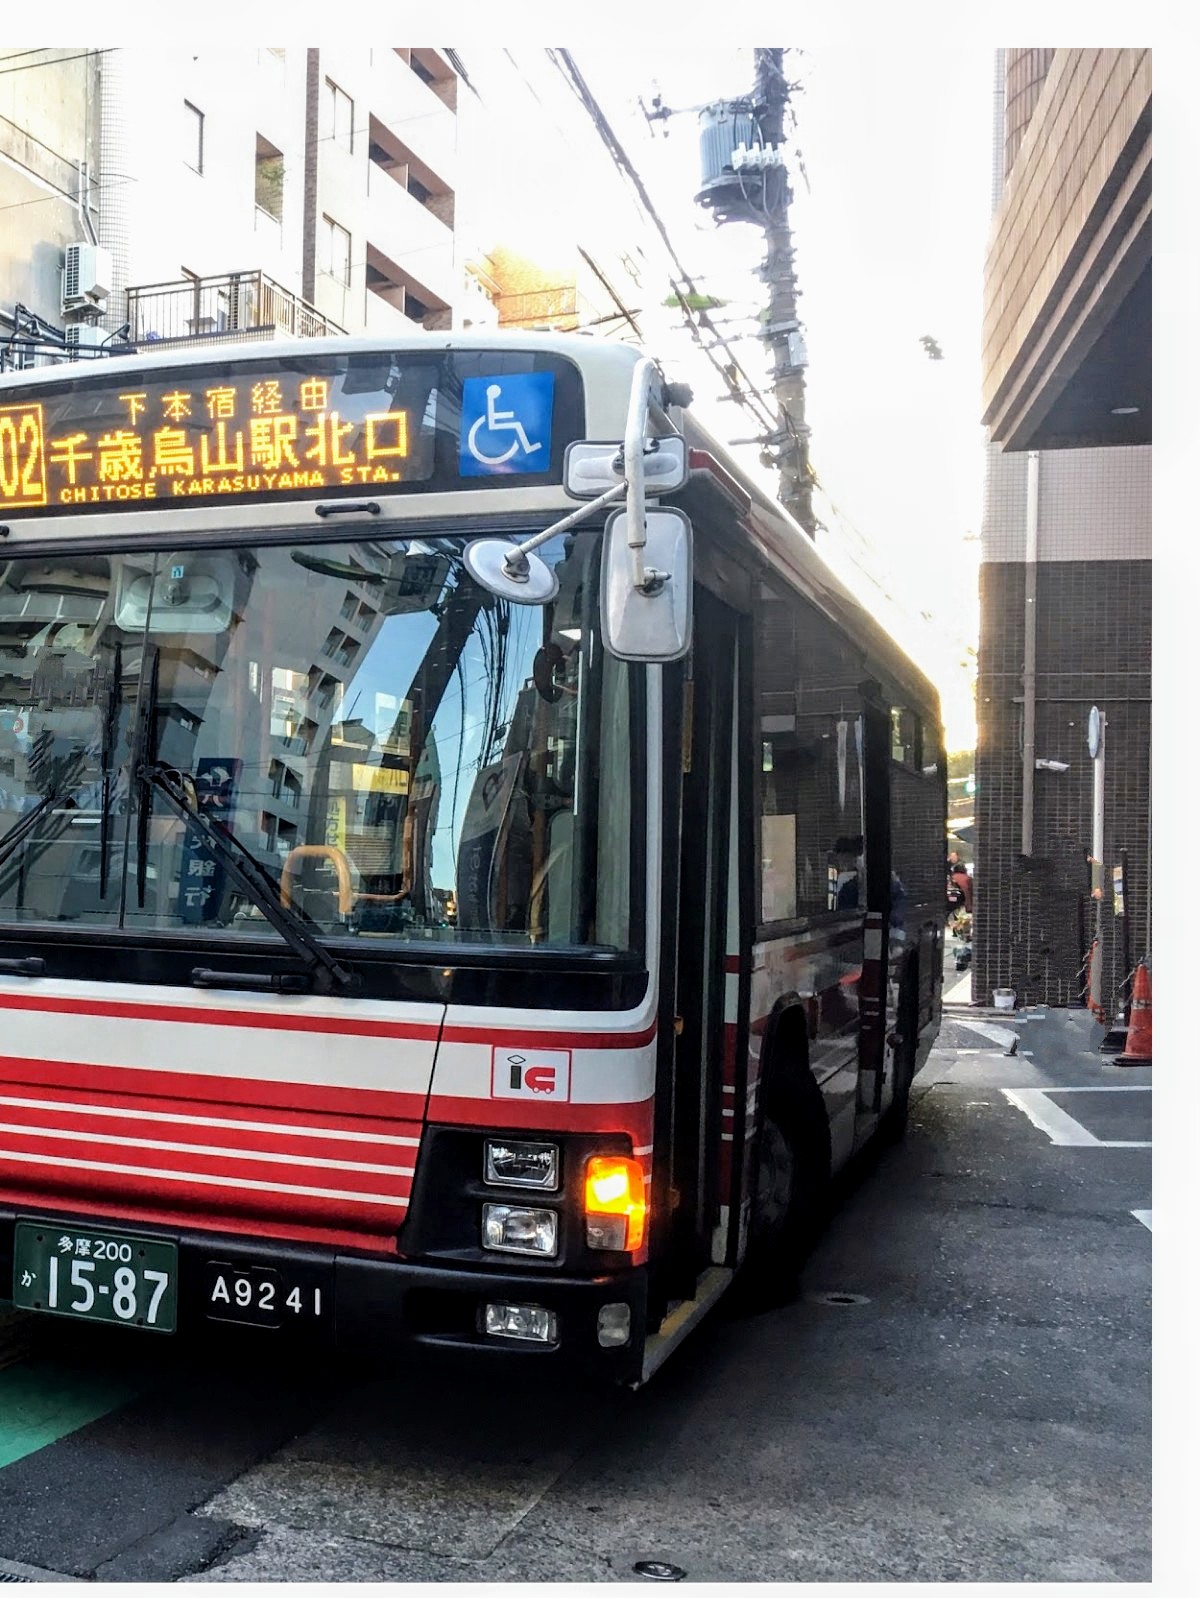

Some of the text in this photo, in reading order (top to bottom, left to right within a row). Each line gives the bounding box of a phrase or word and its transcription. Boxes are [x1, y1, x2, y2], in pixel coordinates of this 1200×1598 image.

[118, 377, 329, 427] 下本宿経由
[50, 411, 408, 483] 千歳烏山駅北口
[60, 468, 401, 504] CHITOSE KARASUYAMA STA.
[58, 1235, 132, 1263] 多摩200
[20, 1256, 169, 1324] か 15-87
[211, 1275, 321, 1316] A9241
